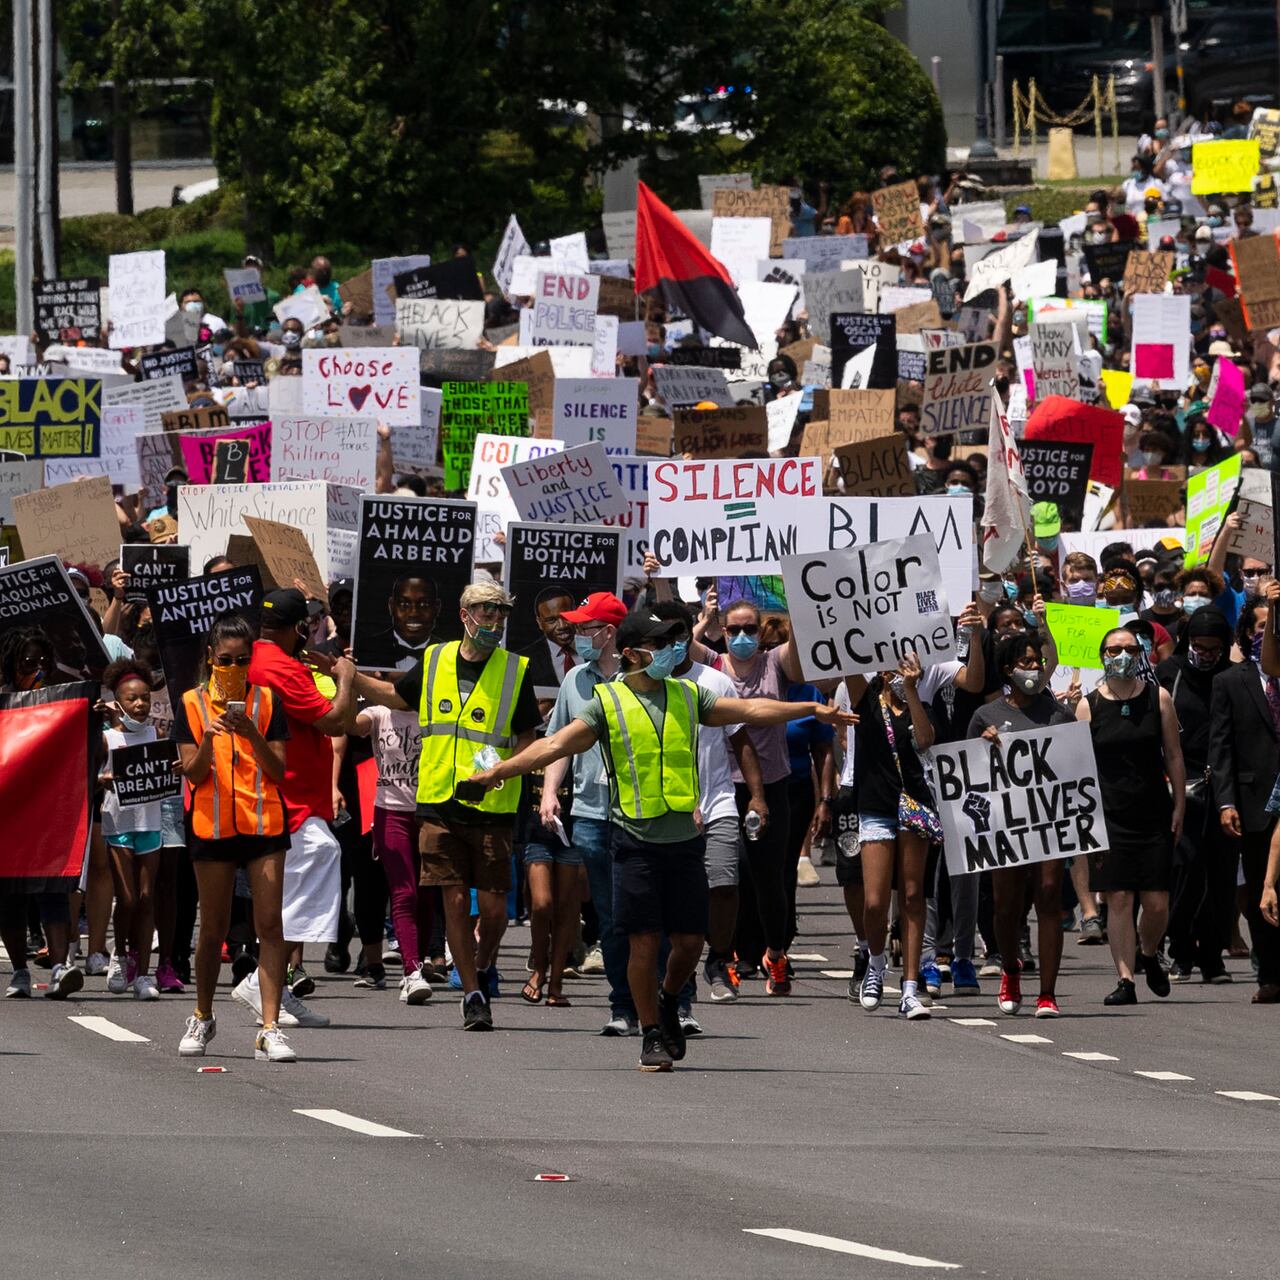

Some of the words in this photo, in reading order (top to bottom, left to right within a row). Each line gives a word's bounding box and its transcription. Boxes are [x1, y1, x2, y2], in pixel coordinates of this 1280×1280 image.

[319, 358, 393, 377] Choose
[930, 346, 997, 372] END
[924, 396, 990, 432] SILENCE
[510, 455, 592, 486] Liberty
[654, 460, 816, 502] SILENCE
[542, 479, 570, 495] and
[368, 504, 448, 521] JUSTICE
[452, 511, 471, 520] FOR
[528, 482, 612, 520] JUSTICE
[366, 524, 472, 542] AHMAUD
[518, 531, 593, 548] JUSTICE
[597, 538, 615, 546] FOR
[374, 544, 464, 563] ARBERY
[524, 549, 605, 565] BOTHAM
[40, 566, 56, 577] FOR
[540, 566, 587, 579] JEAN
[801, 550, 921, 602] Color
[156, 578, 229, 604] JUSTICE
[233, 576, 252, 586] FOR
[160, 590, 254, 622] ANTHONY
[817, 604, 837, 627] is
[854, 592, 901, 619] NOT
[811, 640, 841, 671] a
[844, 624, 950, 664] Crime
[126, 759, 169, 778] CAN'T
[936, 737, 1057, 801] BLACK
[118, 774, 180, 794] BREATHE
[1003, 778, 1096, 829] LIVES
[964, 820, 1102, 872] MATTER
